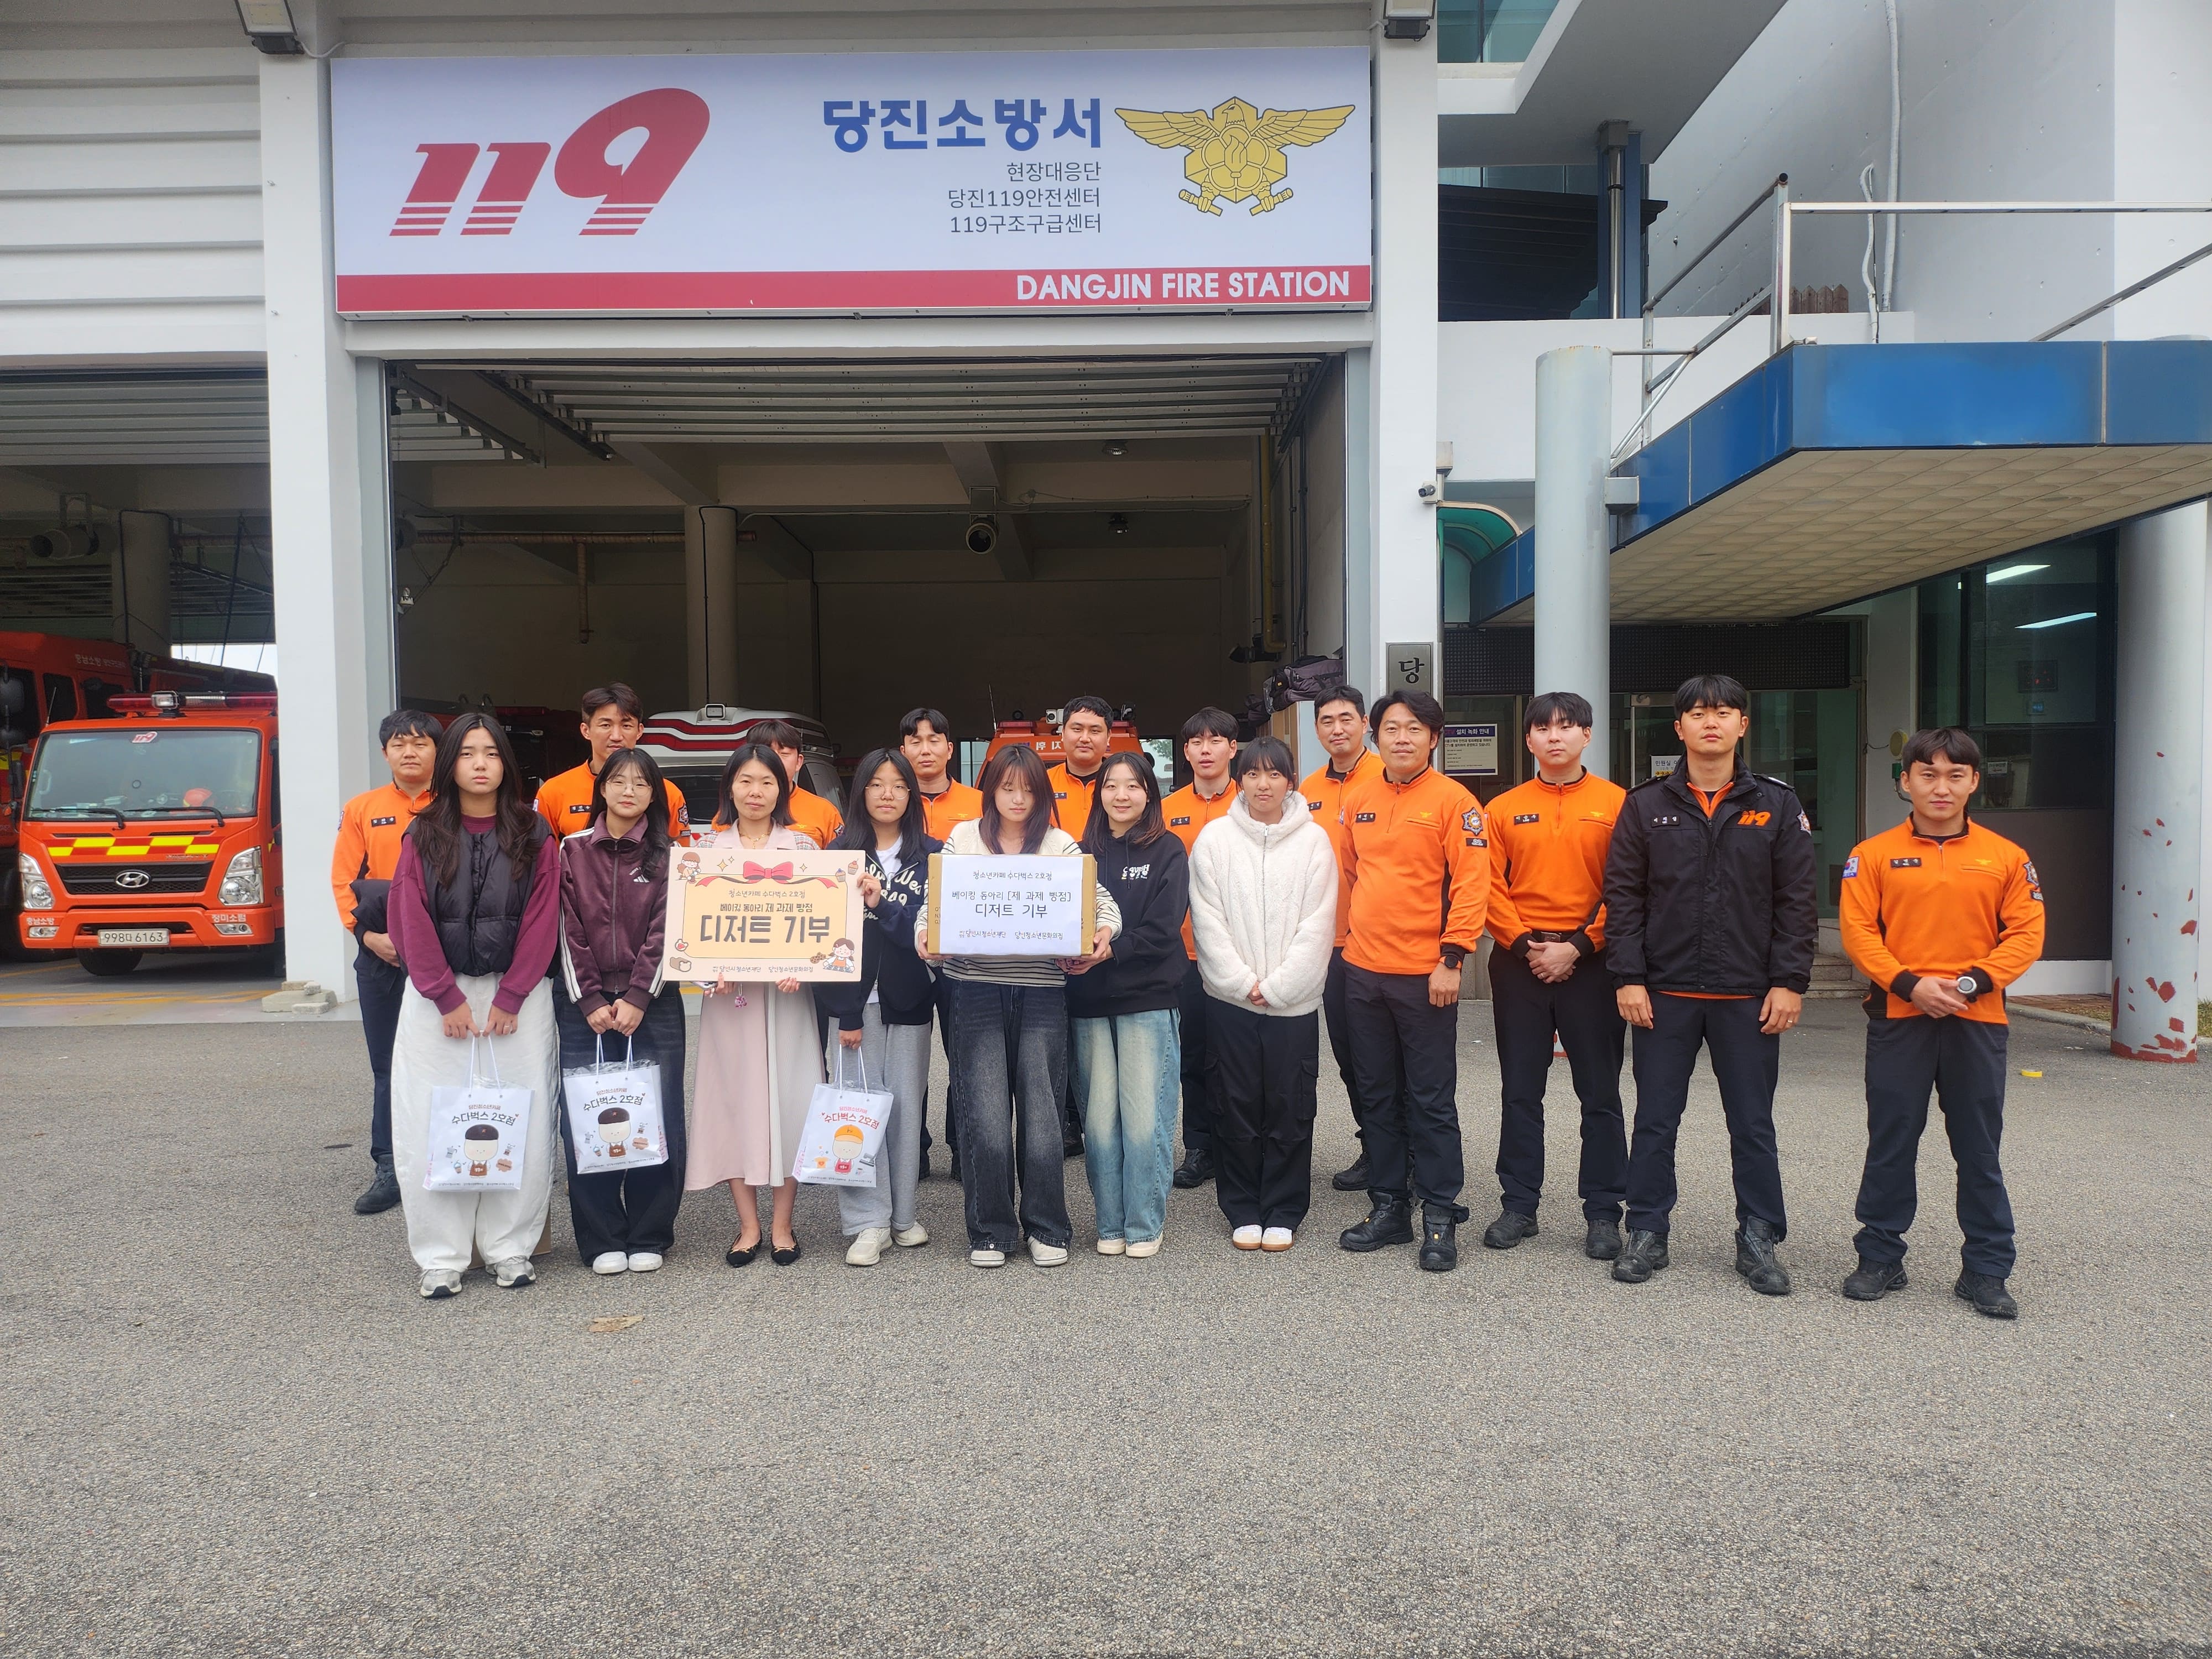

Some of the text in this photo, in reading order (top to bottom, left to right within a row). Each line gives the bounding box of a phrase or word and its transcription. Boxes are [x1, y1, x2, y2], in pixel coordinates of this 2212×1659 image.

[824, 98, 1102, 153] 당진소방서
[389, 88, 710, 236] 119
[1007, 161, 1101, 182] 현장대응단
[948, 187, 1100, 209] 당진119안전센터
[951, 213, 1101, 234] 119구조구급센터
[1018, 270, 1349, 300] DANGJIN FIRE STATION
[1399, 657, 1425, 684] 당
[1738, 811, 1771, 826] 119
[973, 870, 1052, 881] 청소년카페 수다벅스 2호점
[728, 889, 805, 899] 청소년카페 수다벅스 2호점
[952, 890, 1071, 902] 베이킹 동아리 [제 과제 빵점]
[720, 903, 813, 912] 베이킹 동아리 제 과제 빵점
[975, 903, 1048, 919] 디저트 기부
[135, 932, 164, 942] 6163
[701, 915, 830, 943] 디저트 기부
[583, 1095, 644, 1111] 수다벅스 2호점
[451, 1112, 517, 1126] 수다벅스 2호점
[823, 1112, 880, 1130] 수다벅스 2호점
